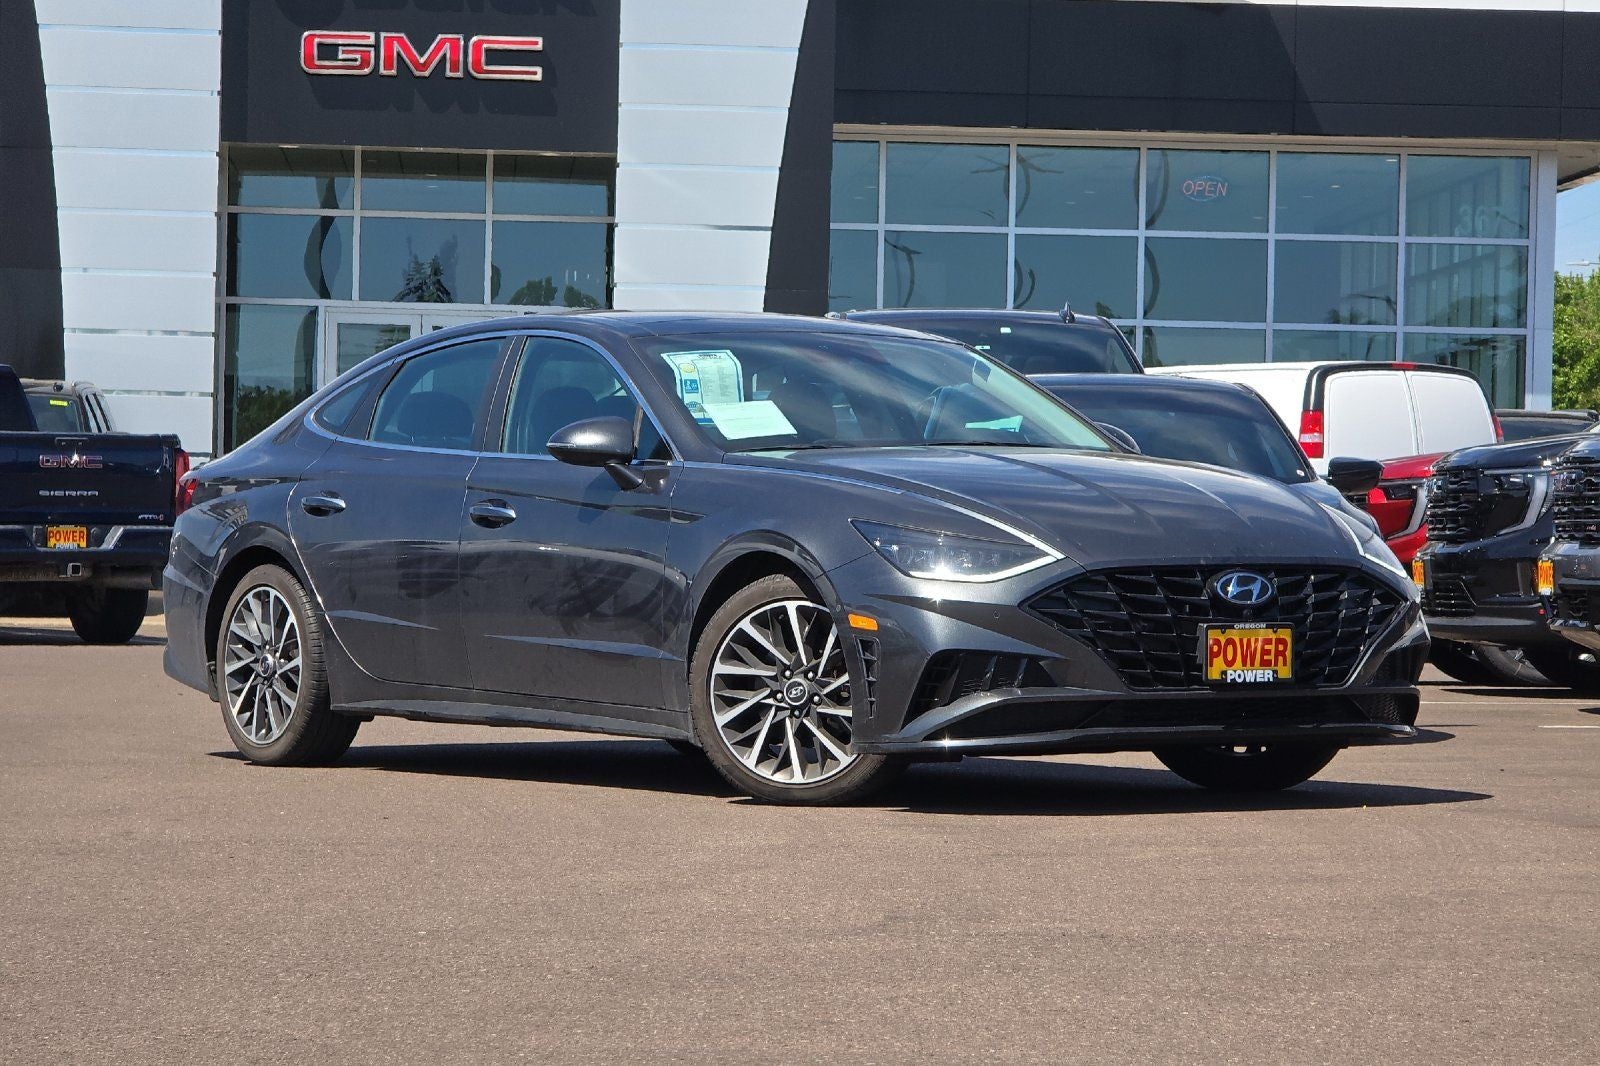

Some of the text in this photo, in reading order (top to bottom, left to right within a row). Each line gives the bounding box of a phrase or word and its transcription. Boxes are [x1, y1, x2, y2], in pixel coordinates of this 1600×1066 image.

[300, 30, 543, 81] GMC
[1182, 180, 1228, 198] OPEN
[39, 454, 102, 468] GMC
[48, 530, 85, 542] POWER
[1209, 637, 1289, 667] POWER
[1226, 669, 1274, 683] POWER
